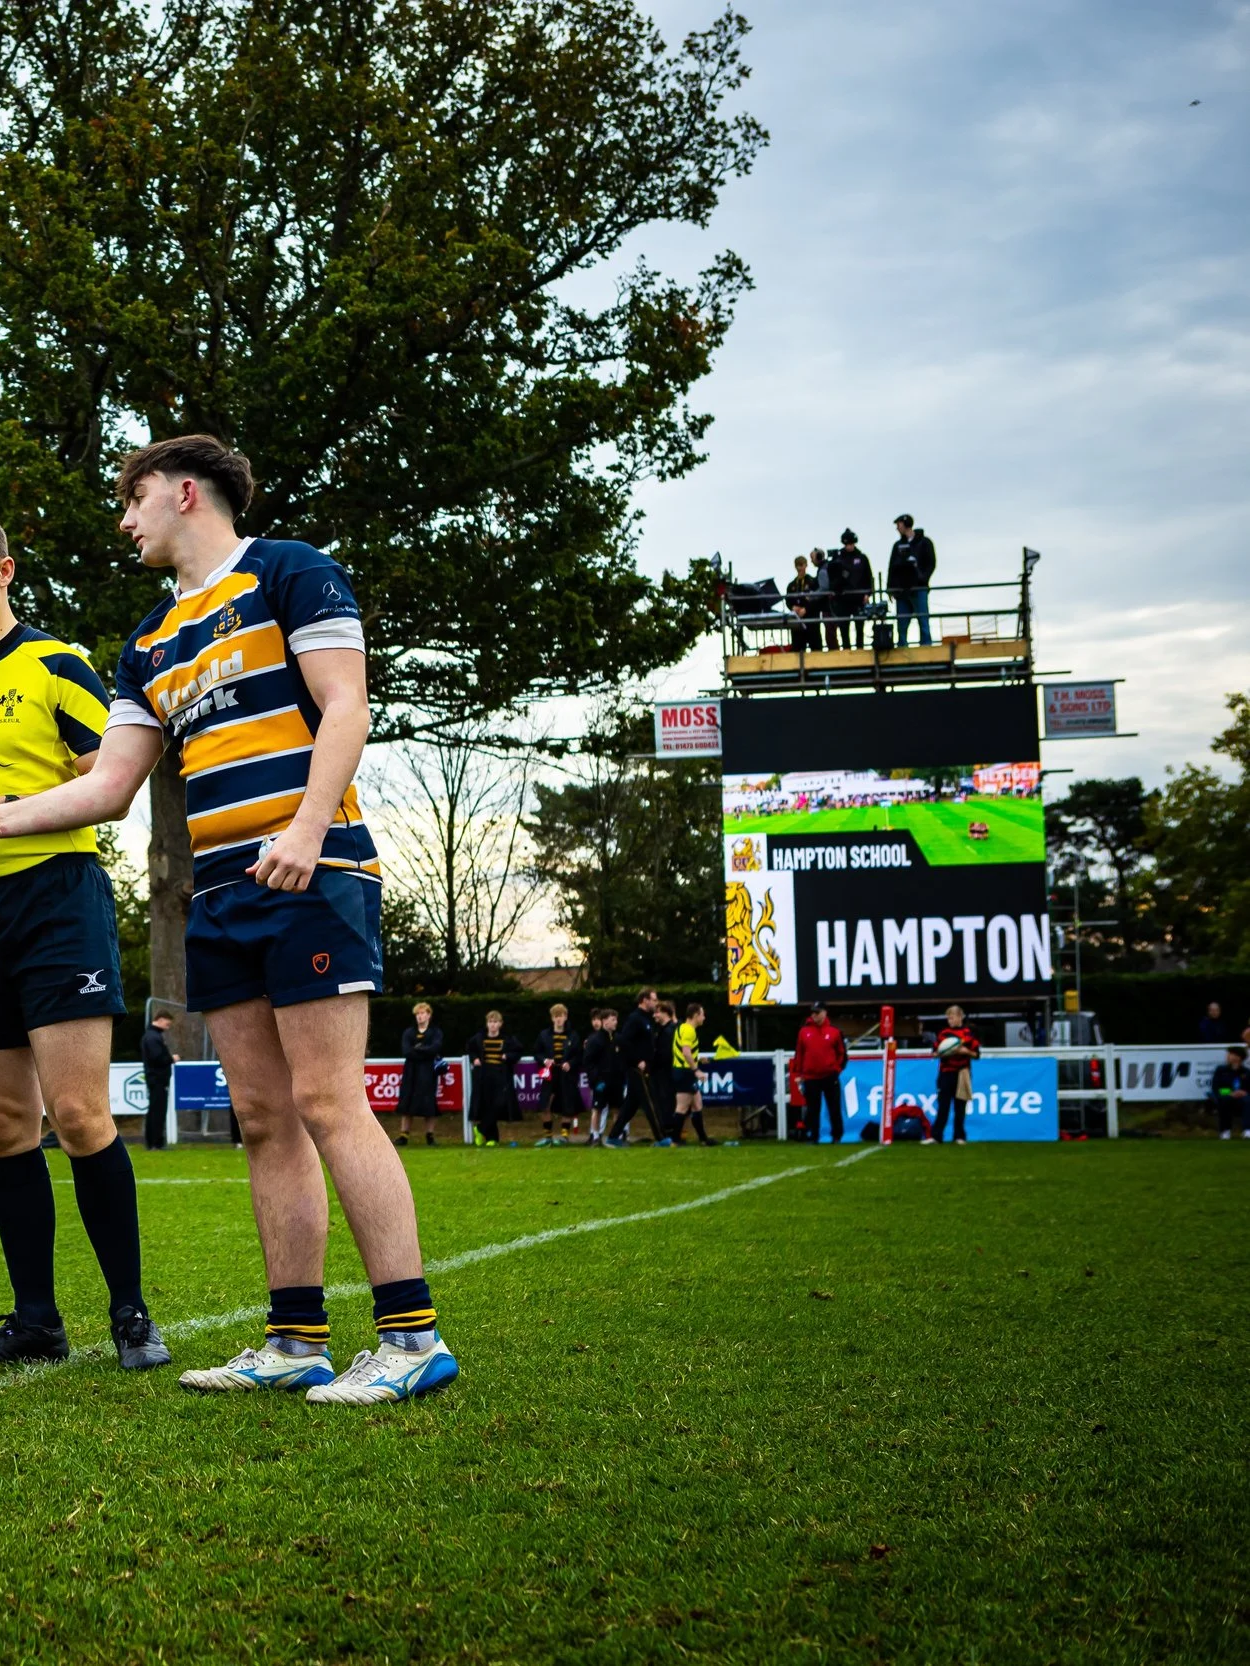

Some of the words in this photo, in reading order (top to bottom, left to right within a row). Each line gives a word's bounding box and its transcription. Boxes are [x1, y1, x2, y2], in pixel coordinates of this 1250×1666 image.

[661, 707, 718, 727] MOSS
[773, 848, 847, 870] HAMPTON
[850, 844, 912, 867] SCHOOL
[816, 914, 1052, 987] HAMPTON
